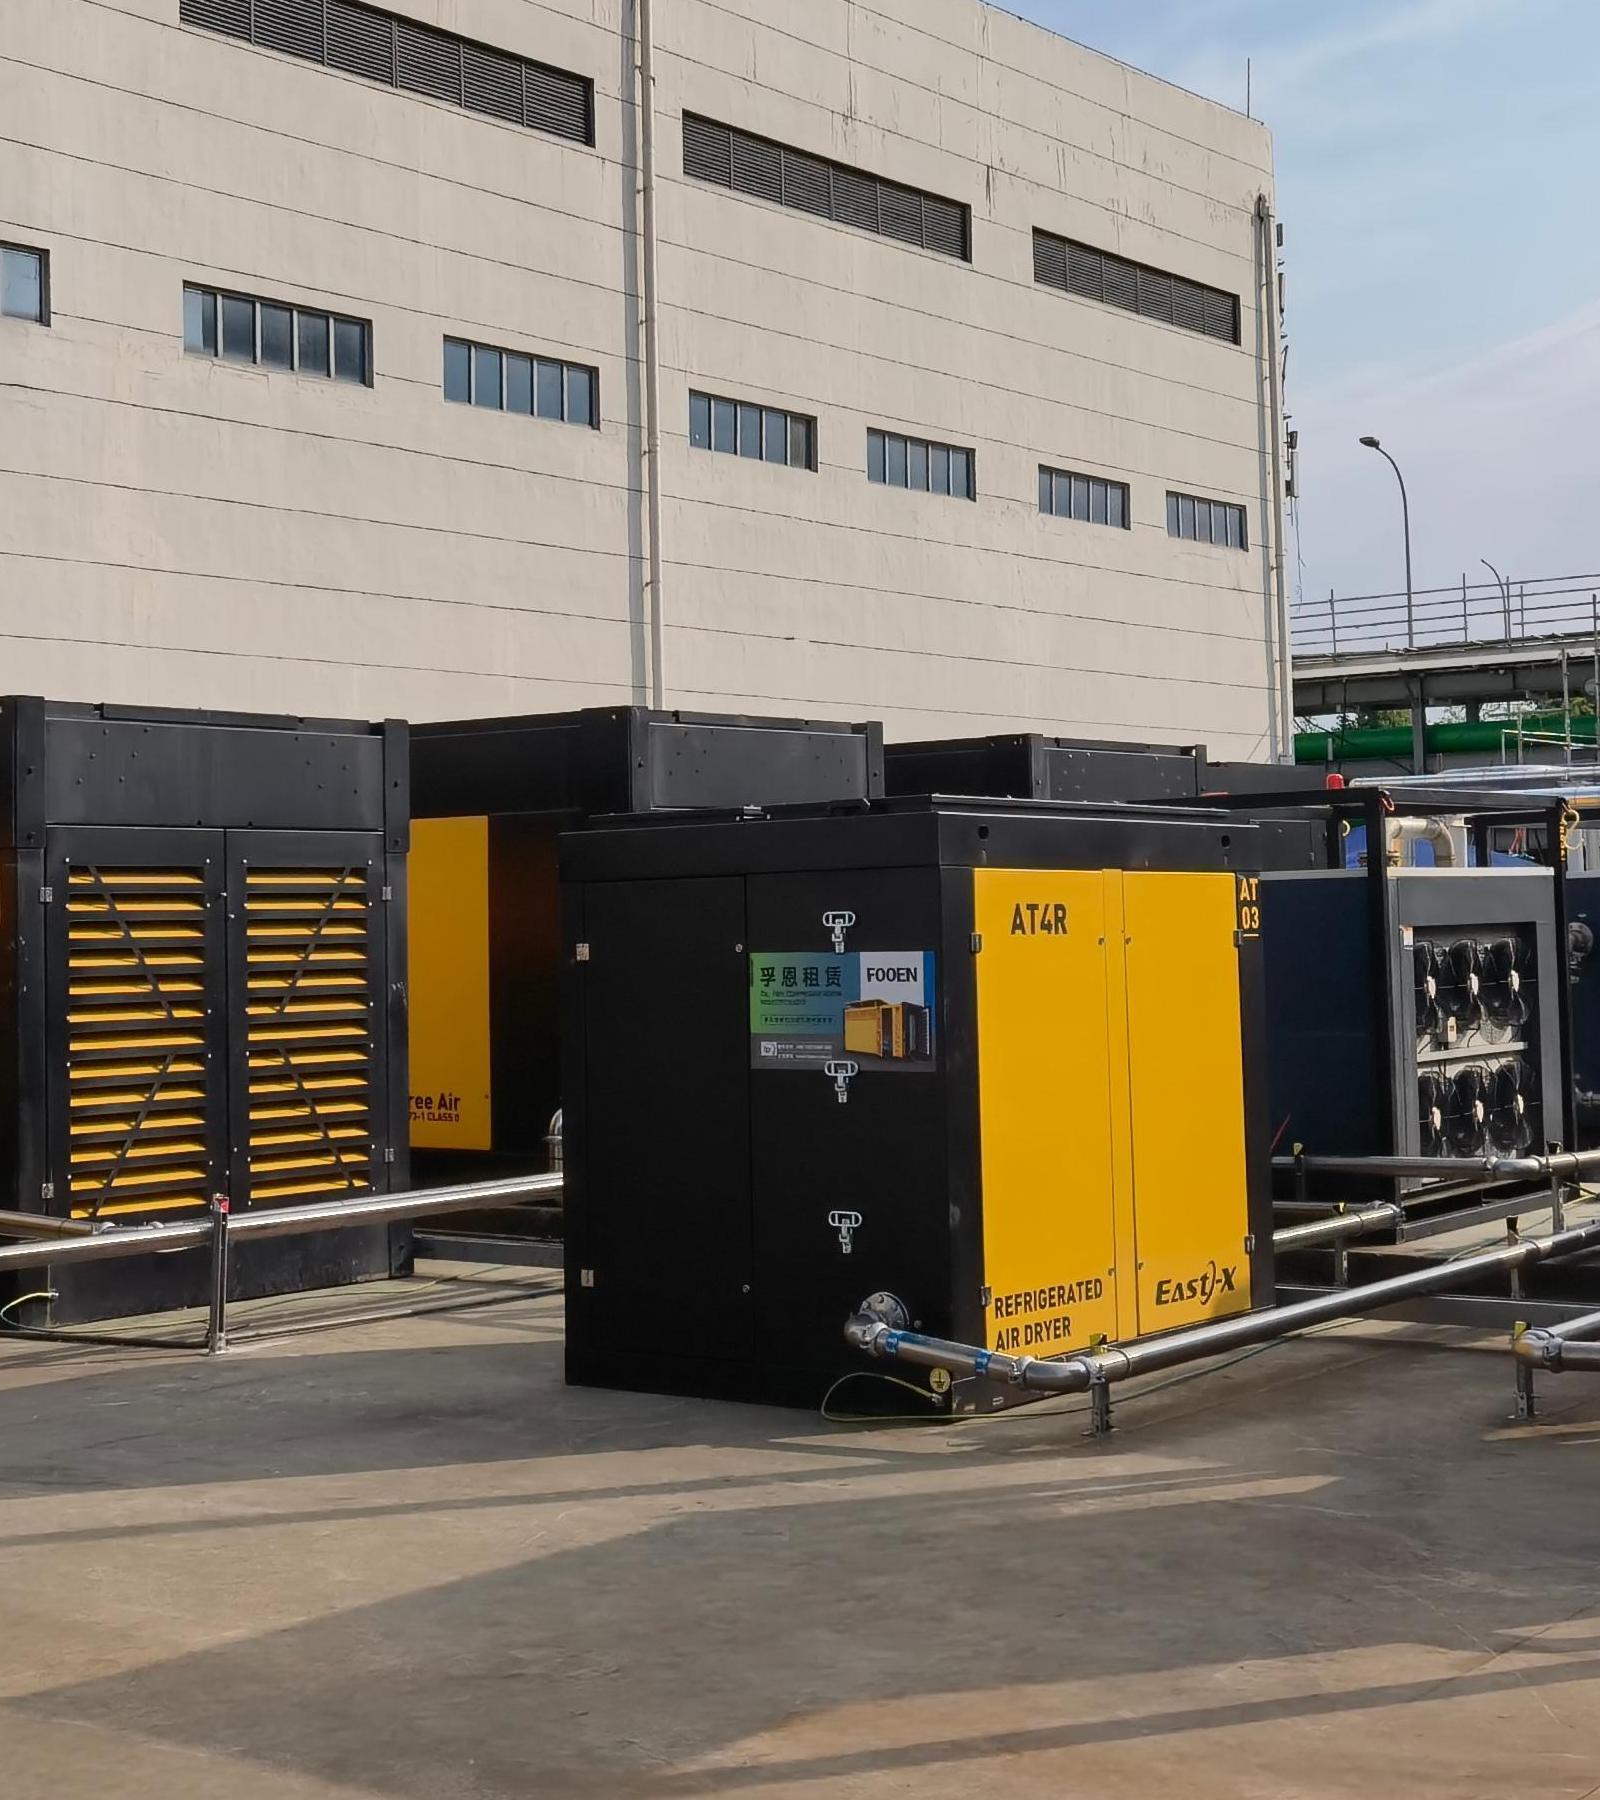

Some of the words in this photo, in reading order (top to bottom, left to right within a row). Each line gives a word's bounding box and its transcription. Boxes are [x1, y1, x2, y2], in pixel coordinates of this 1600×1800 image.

[1240, 877, 1259, 901] AT
[1010, 903, 1068, 935] AT4R
[1241, 906, 1260, 930] 03
[760, 966, 842, 988] 孚恩租赁
[866, 967, 918, 983] FOOEN
[437, 1092, 461, 1111] Air
[995, 1278, 1103, 1320] REFRIGERATED
[996, 1326, 1020, 1351] AIR
[1024, 1315, 1071, 1346] DRYER
